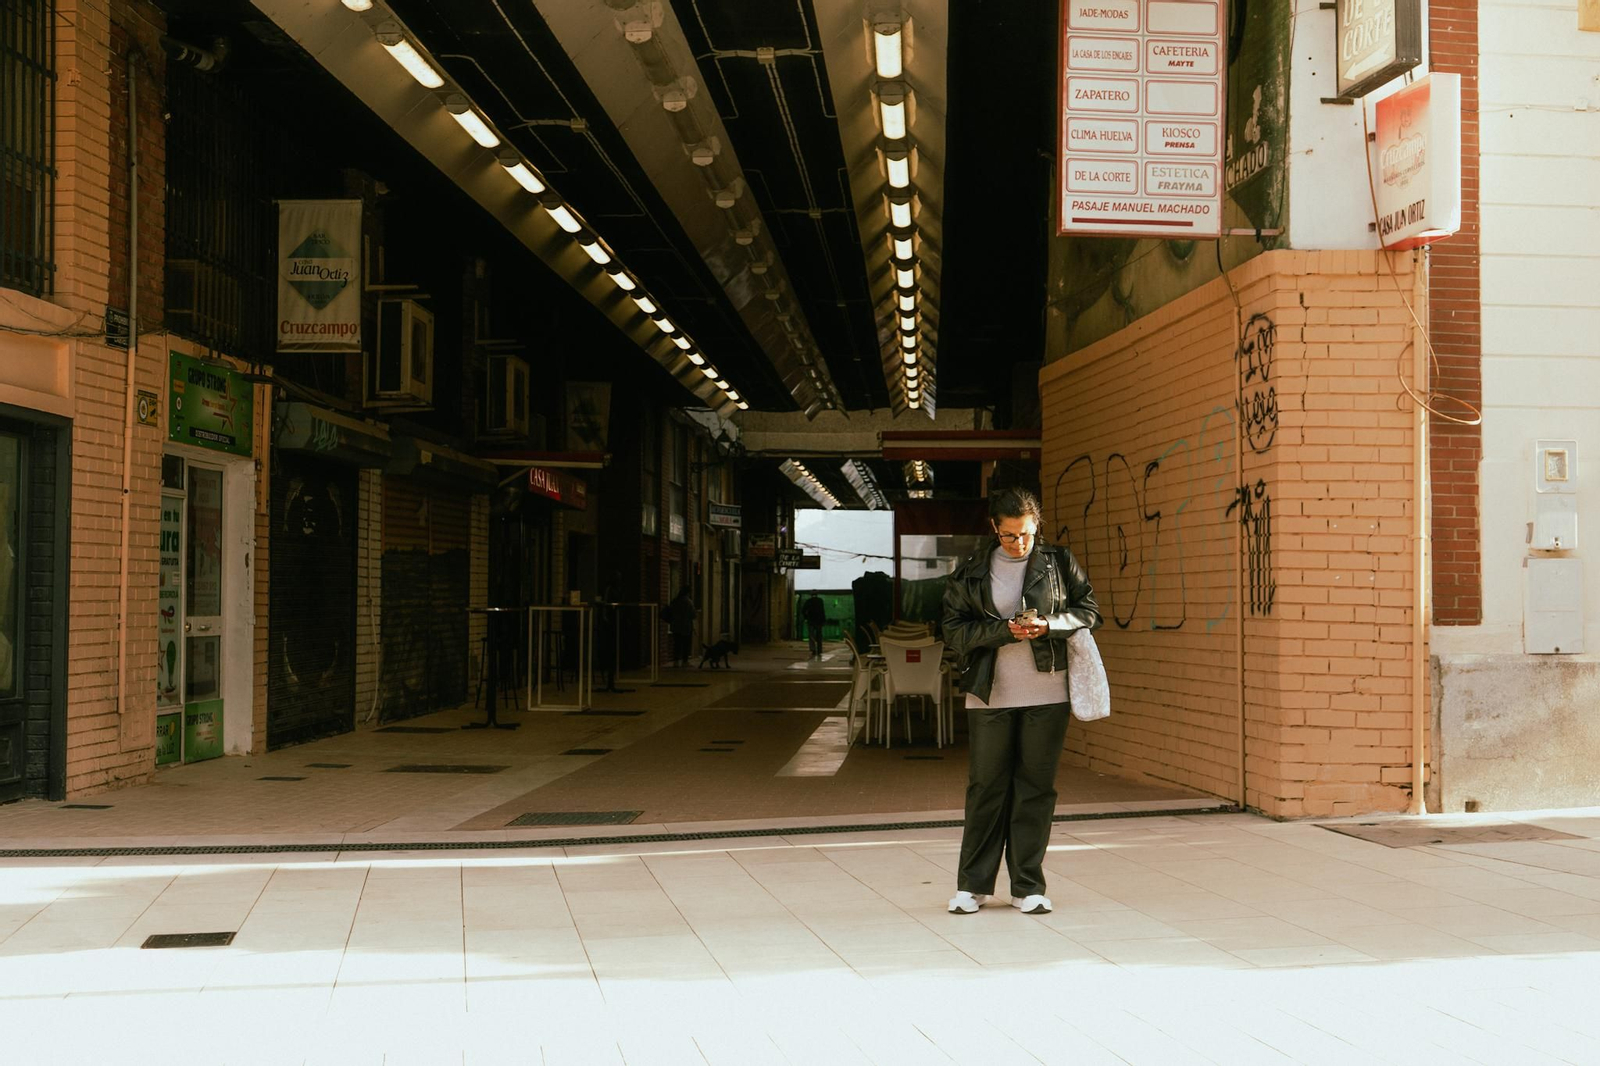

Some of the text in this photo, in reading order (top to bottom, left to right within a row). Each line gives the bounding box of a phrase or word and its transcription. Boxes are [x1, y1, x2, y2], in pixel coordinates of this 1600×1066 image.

[1079, 8, 1129, 20] JADE-MODAS
[1343, 8, 1391, 62] CORTE
[1072, 49, 1132, 61] LA CASA DE LOS ENCAJES
[1152, 45, 1209, 57] CAFETERIA
[1167, 60, 1195, 68] MAYTE
[1075, 89, 1130, 101] ZAPATERO
[1071, 129, 1133, 142] CLIMA HUELVA
[1162, 127, 1201, 139] KIOSCO
[1164, 141, 1195, 149] PRENSA
[1226, 143, 1267, 188] CHADO
[1074, 170, 1131, 182] DE LA CORTE
[1151, 166, 1210, 179] ESTETICA
[1157, 181, 1203, 192] FRAYMA
[1071, 200, 1210, 215] PASAJE MANUEL MACHADO
[1408, 199, 1425, 225] ORTIZ
[290, 261, 320, 275] Juan
[280, 320, 357, 337] Cruzcampo
[530, 467, 546, 489] CASA
[160, 530, 179, 552] ura
